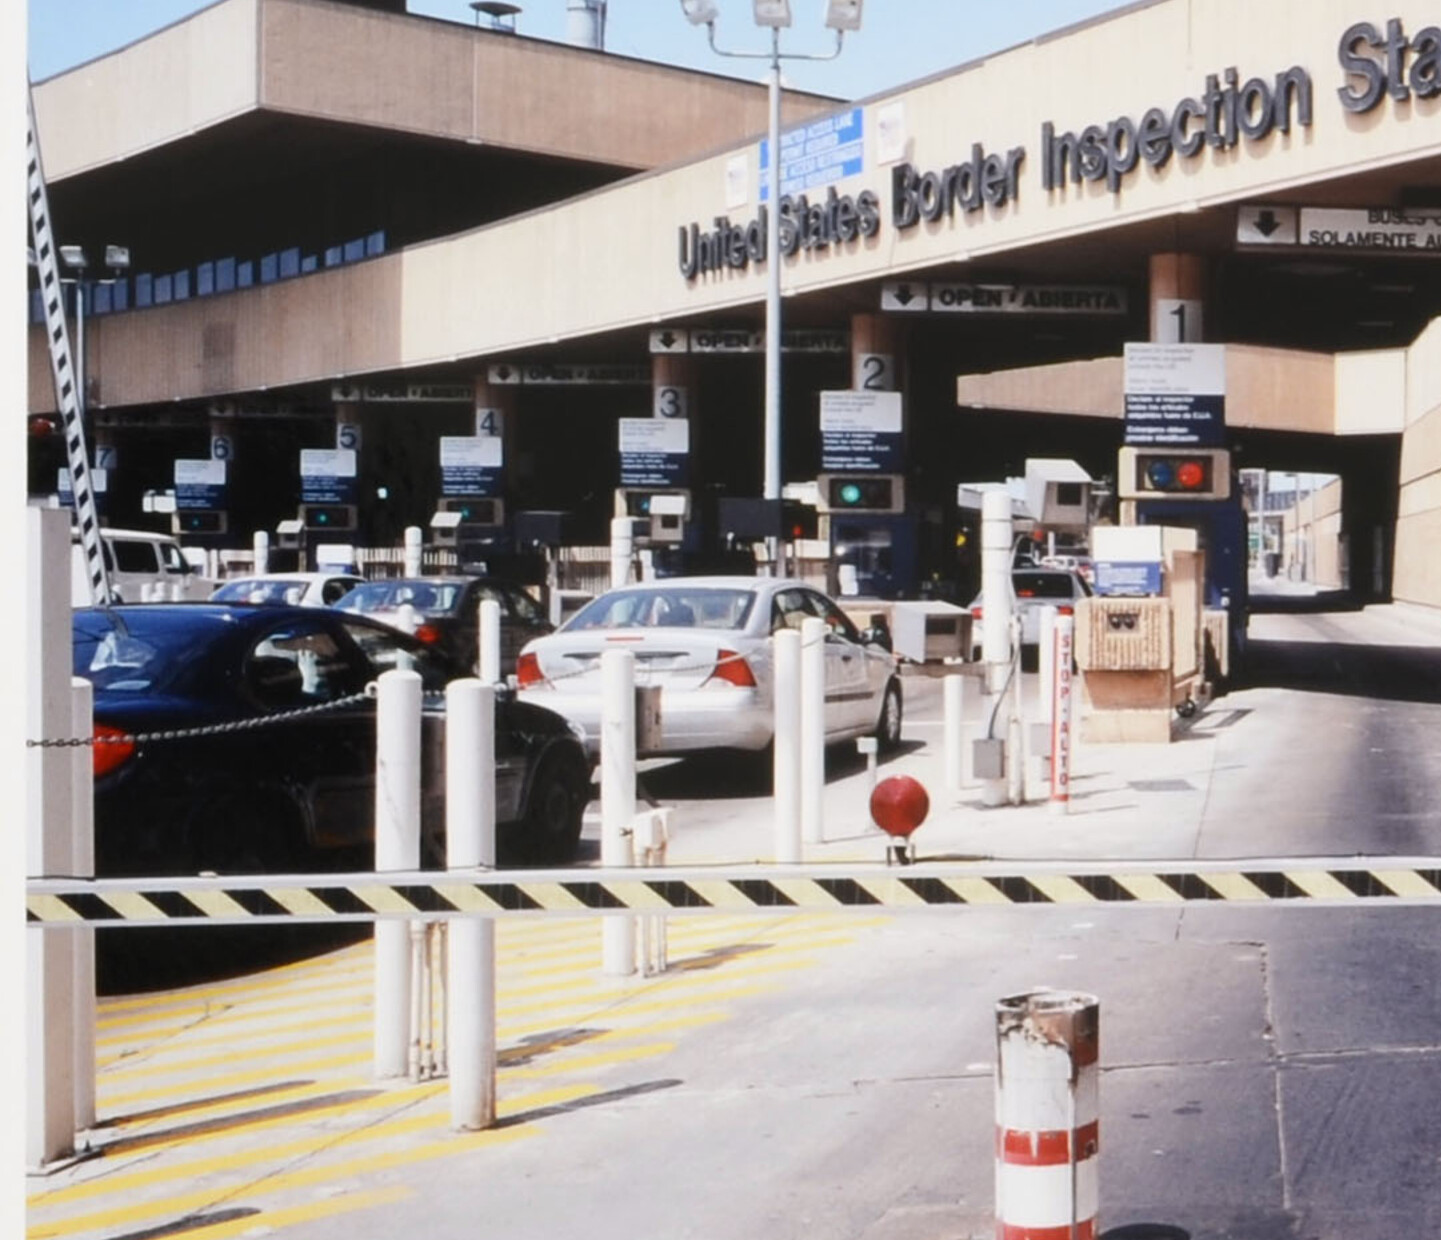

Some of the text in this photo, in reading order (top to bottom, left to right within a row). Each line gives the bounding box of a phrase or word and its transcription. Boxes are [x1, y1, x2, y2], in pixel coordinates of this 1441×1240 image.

[679, 205, 767, 279] United
[779, 186, 879, 257] States
[892, 143, 1025, 230] Border
[1042, 65, 1312, 193] Inspection
[1309, 230, 1415, 249] SOLAMENTE
[939, 288, 1120, 309] OPEN ABIERTA
[1170, 304, 1185, 343] 1
[864, 357, 885, 389] 2
[660, 388, 680, 418] 3
[480, 411, 497, 435] 4
[214, 437, 229, 460] 6
[340, 427, 357, 449] 5
